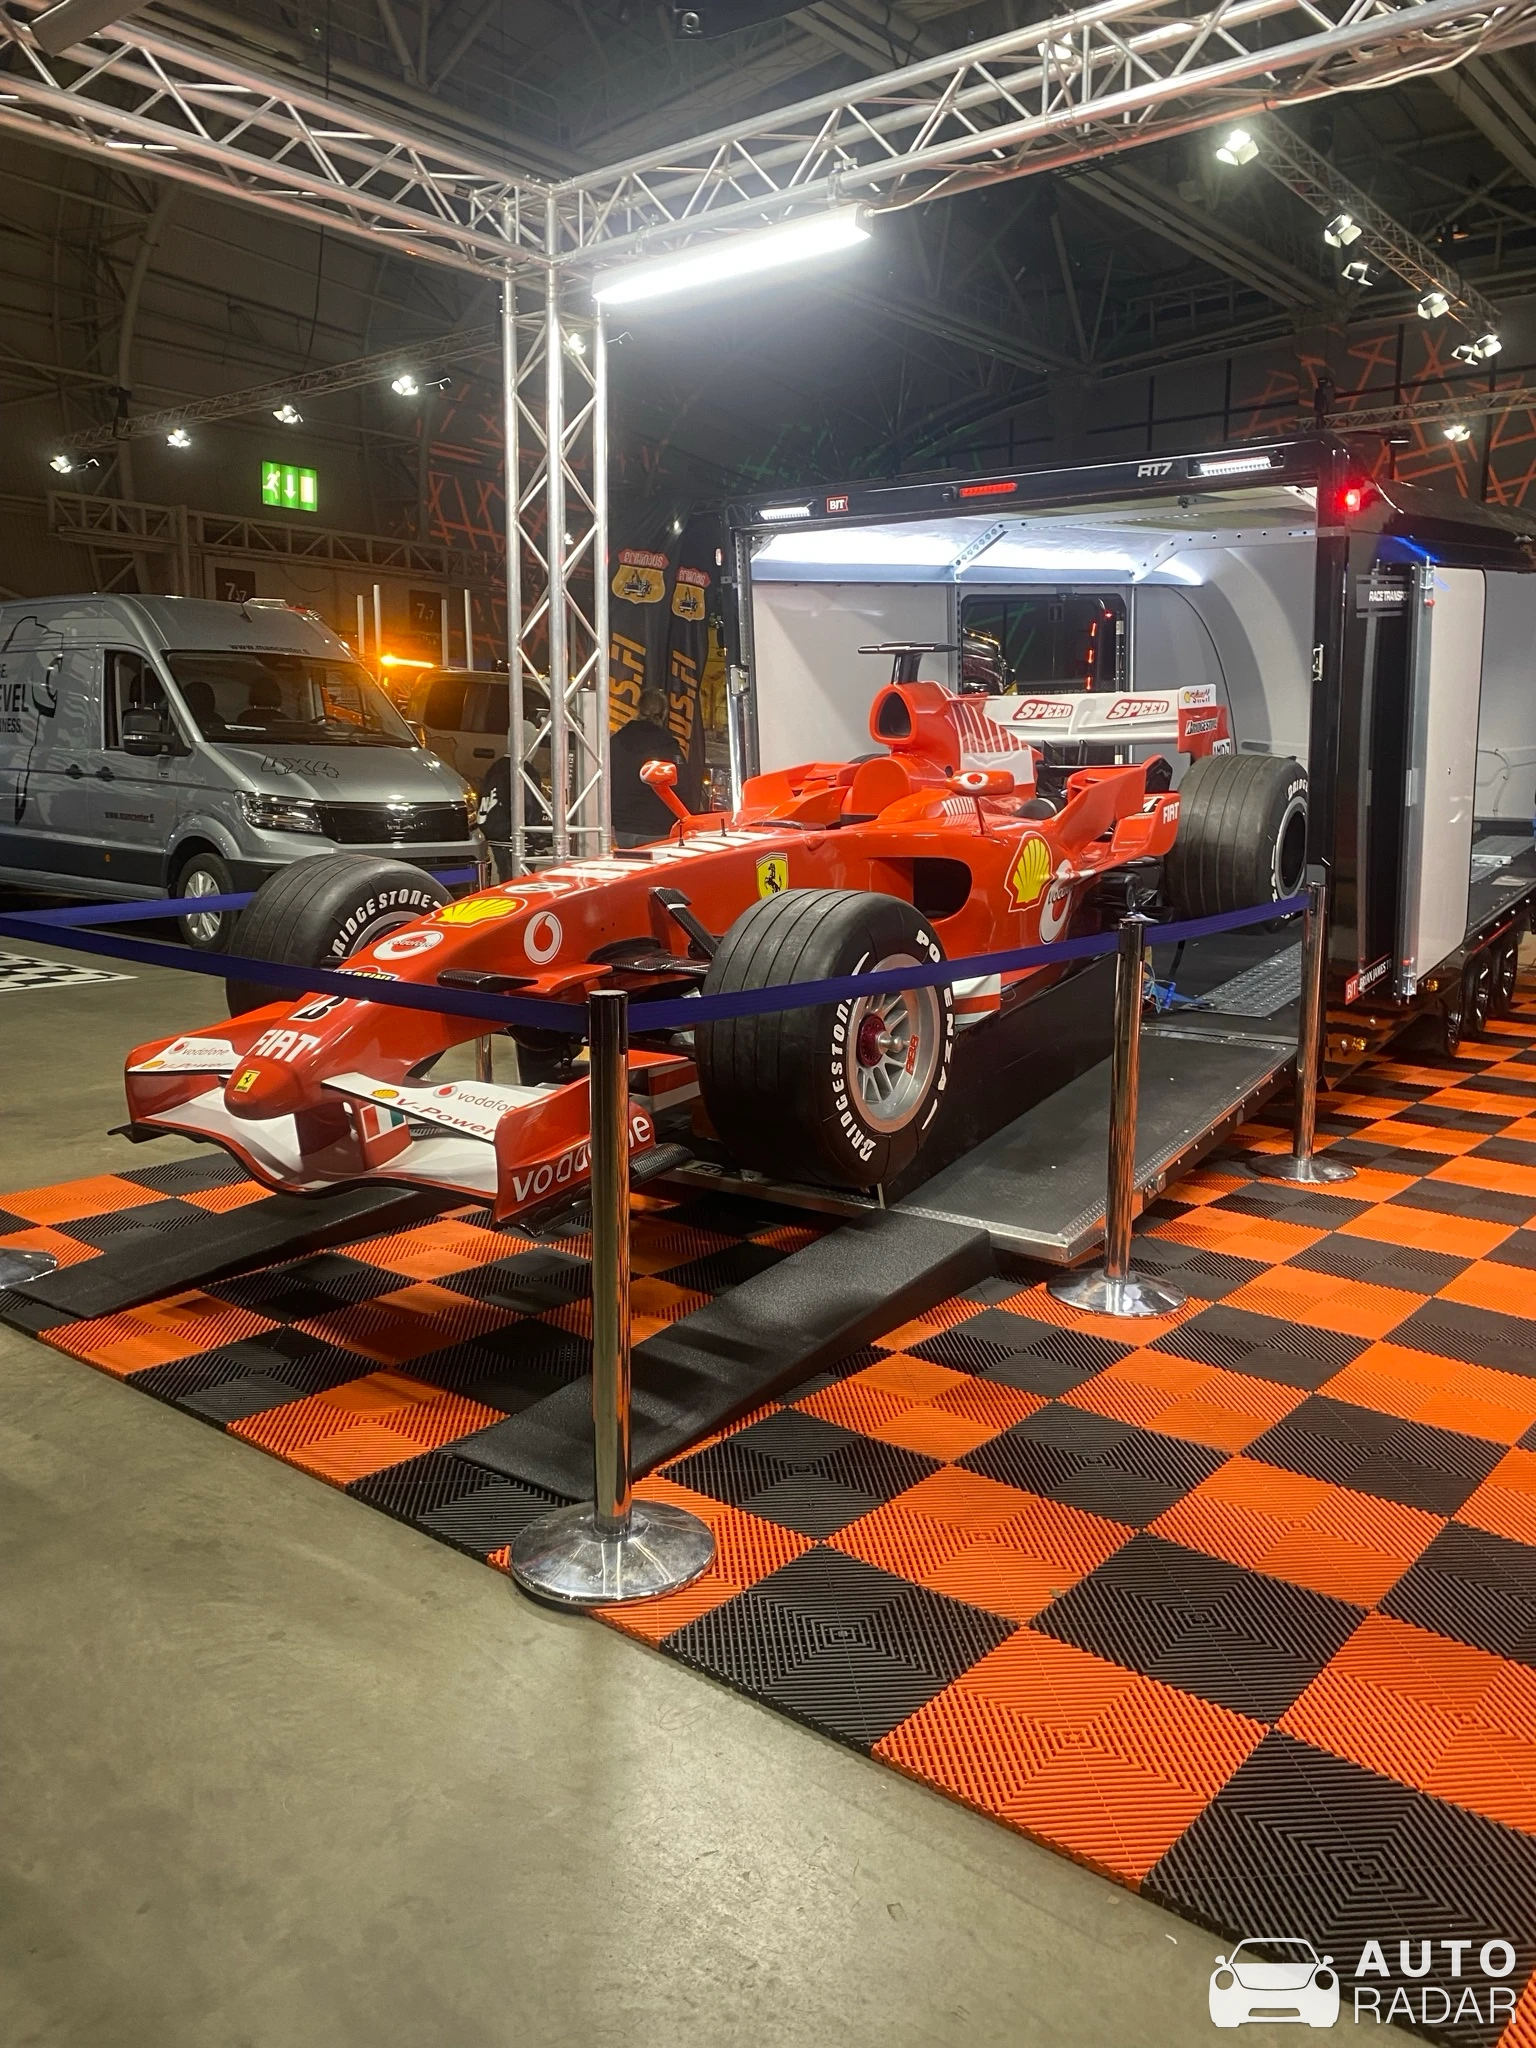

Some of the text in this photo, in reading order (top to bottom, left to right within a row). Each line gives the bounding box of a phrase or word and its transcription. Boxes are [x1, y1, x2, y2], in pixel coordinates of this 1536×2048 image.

[1137, 462, 1172, 477] RT7
[1368, 591, 1384, 601] RACE
[1016, 702, 1073, 720] SPEED
[1109, 701, 1169, 719] SPEED
[1163, 802, 1180, 824] FIAT
[331, 888, 432, 957] RIDGESTONE
[915, 929, 955, 1091] POENZA
[246, 1029, 321, 1063] FIAT
[831, 998, 877, 1162] BRIDGESTON
[457, 1092, 518, 1112] vodafon
[396, 1098, 495, 1136] V-Power
[512, 1115, 651, 1202] vodae
